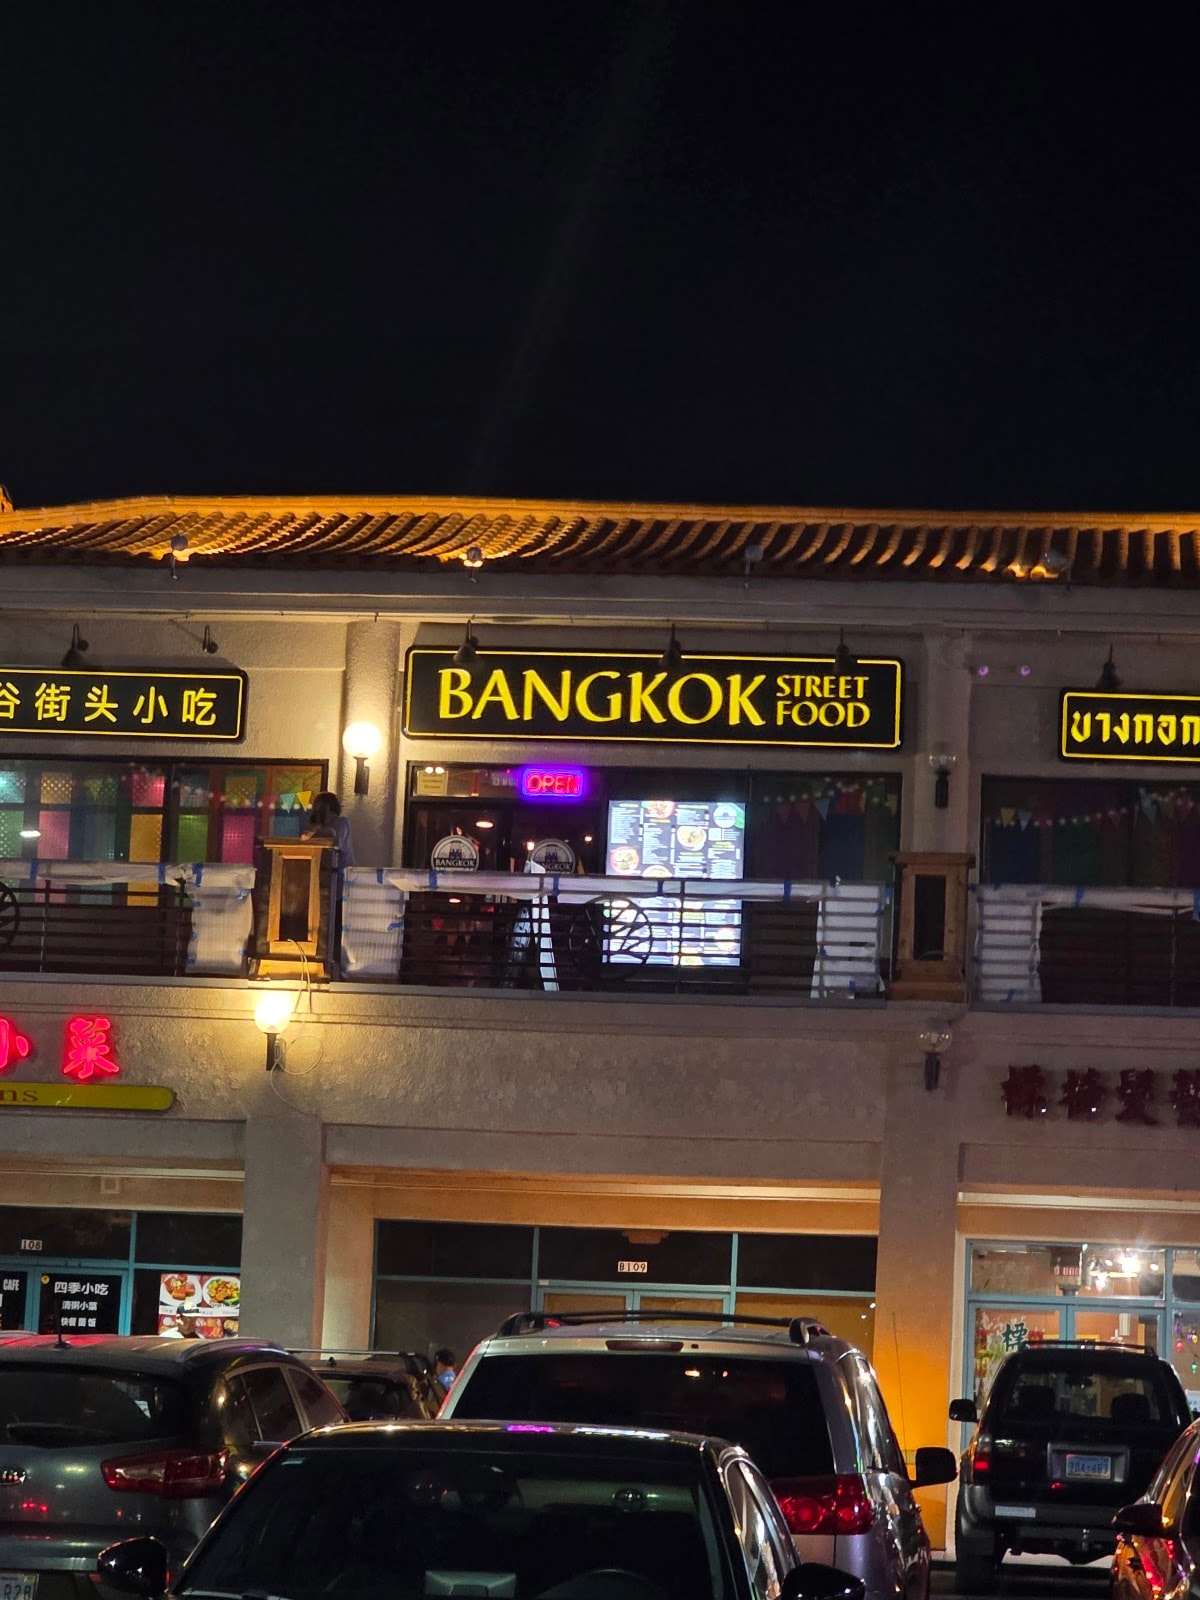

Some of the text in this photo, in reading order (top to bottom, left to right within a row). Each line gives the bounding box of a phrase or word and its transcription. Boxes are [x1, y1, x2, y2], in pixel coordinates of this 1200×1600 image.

[776, 674, 869, 699] STREET
[438, 668, 766, 726] BANGKOK
[776, 701, 870, 727] FOOD
[1071, 710, 1200, 746] บางกอก
[526, 772, 581, 793] OPEN
[435, 858, 475, 867] BANGKOK
[22, 1240, 41, 1250] 108
[619, 1262, 646, 1272] B109
[3, 1278, 20, 1291] CAFE
[54, 1281, 109, 1296] 四季小吃
